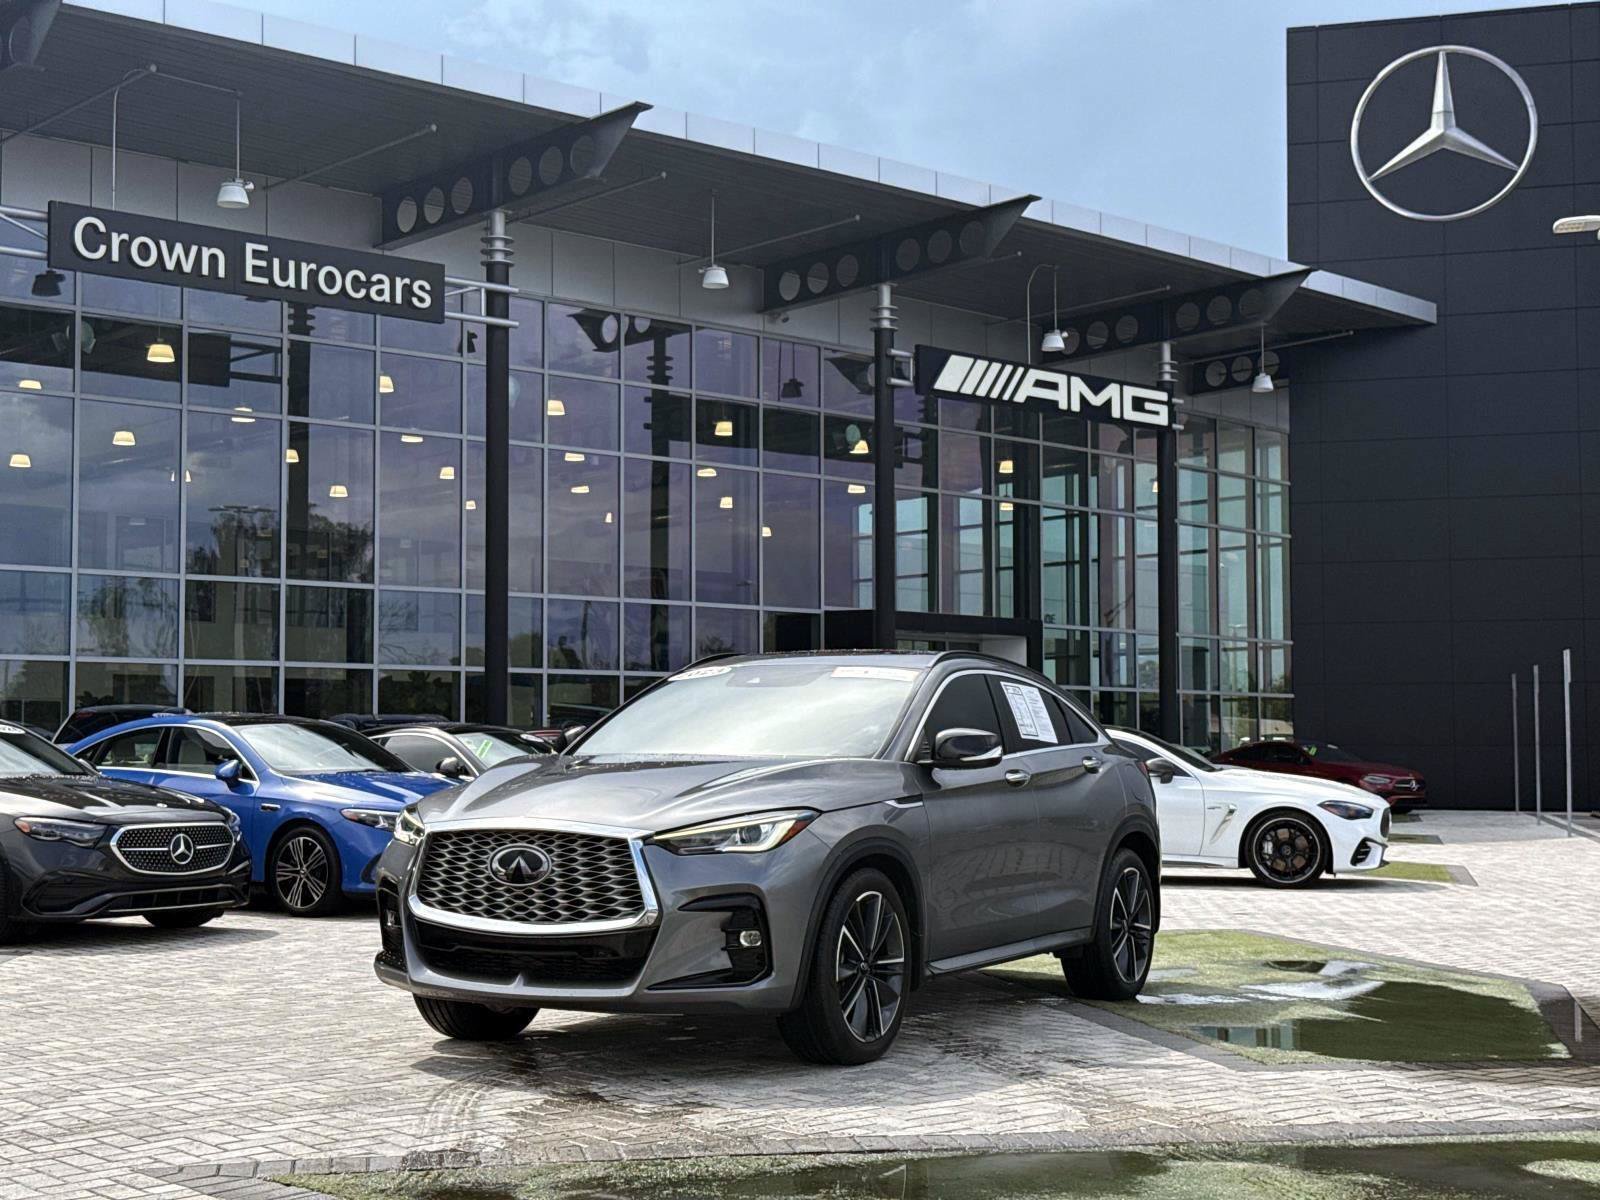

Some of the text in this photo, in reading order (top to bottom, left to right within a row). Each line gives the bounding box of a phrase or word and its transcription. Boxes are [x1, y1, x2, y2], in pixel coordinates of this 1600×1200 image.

[74, 216, 432, 309] Crown Eurocars
[1012, 367, 1169, 426] AMG
